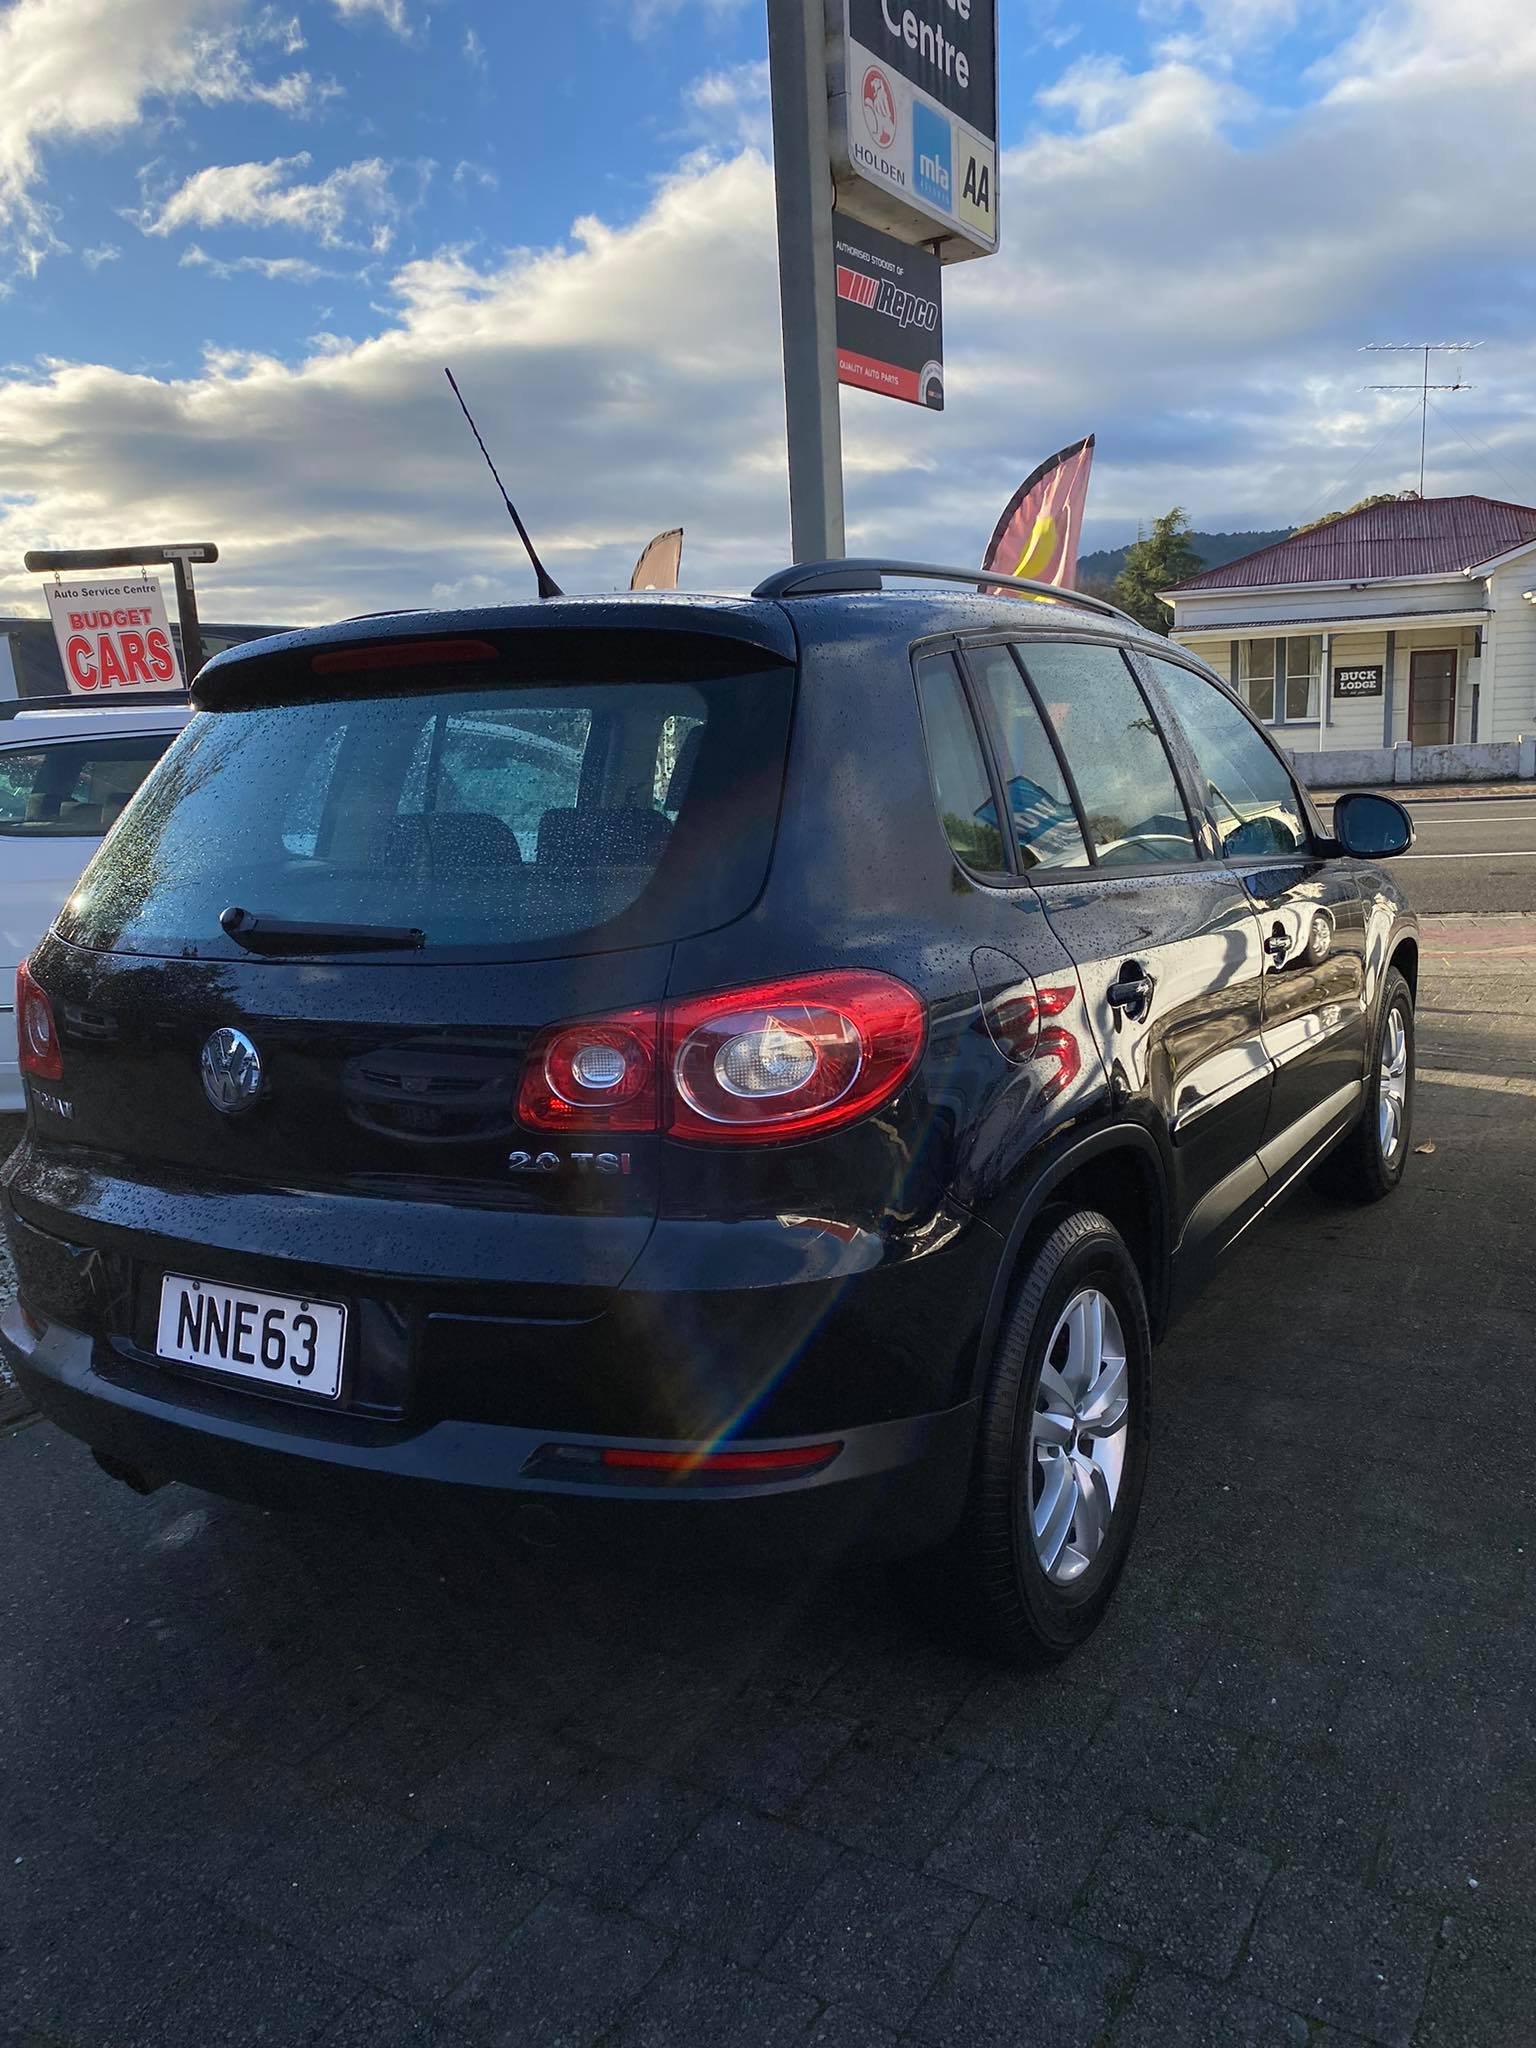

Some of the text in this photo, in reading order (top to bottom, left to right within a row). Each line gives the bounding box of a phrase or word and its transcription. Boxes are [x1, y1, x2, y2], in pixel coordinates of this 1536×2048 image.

[881, 0, 970, 89] Centre
[854, 143, 905, 186] HOLDEN
[962, 156, 989, 213] AA
[836, 240, 904, 276] AUTHORISED STOCKIST OF
[877, 278, 939, 331] Repco
[839, 360, 899, 386] QUALITY AUTO PARTS
[54, 584, 157, 599] Auto Service Centre
[67, 607, 152, 632] BUDGET
[66, 628, 175, 691] CARS
[1340, 670, 1377, 681] BUCK
[1340, 681, 1377, 690] LODGE
[176, 1290, 319, 1377] NNE63
